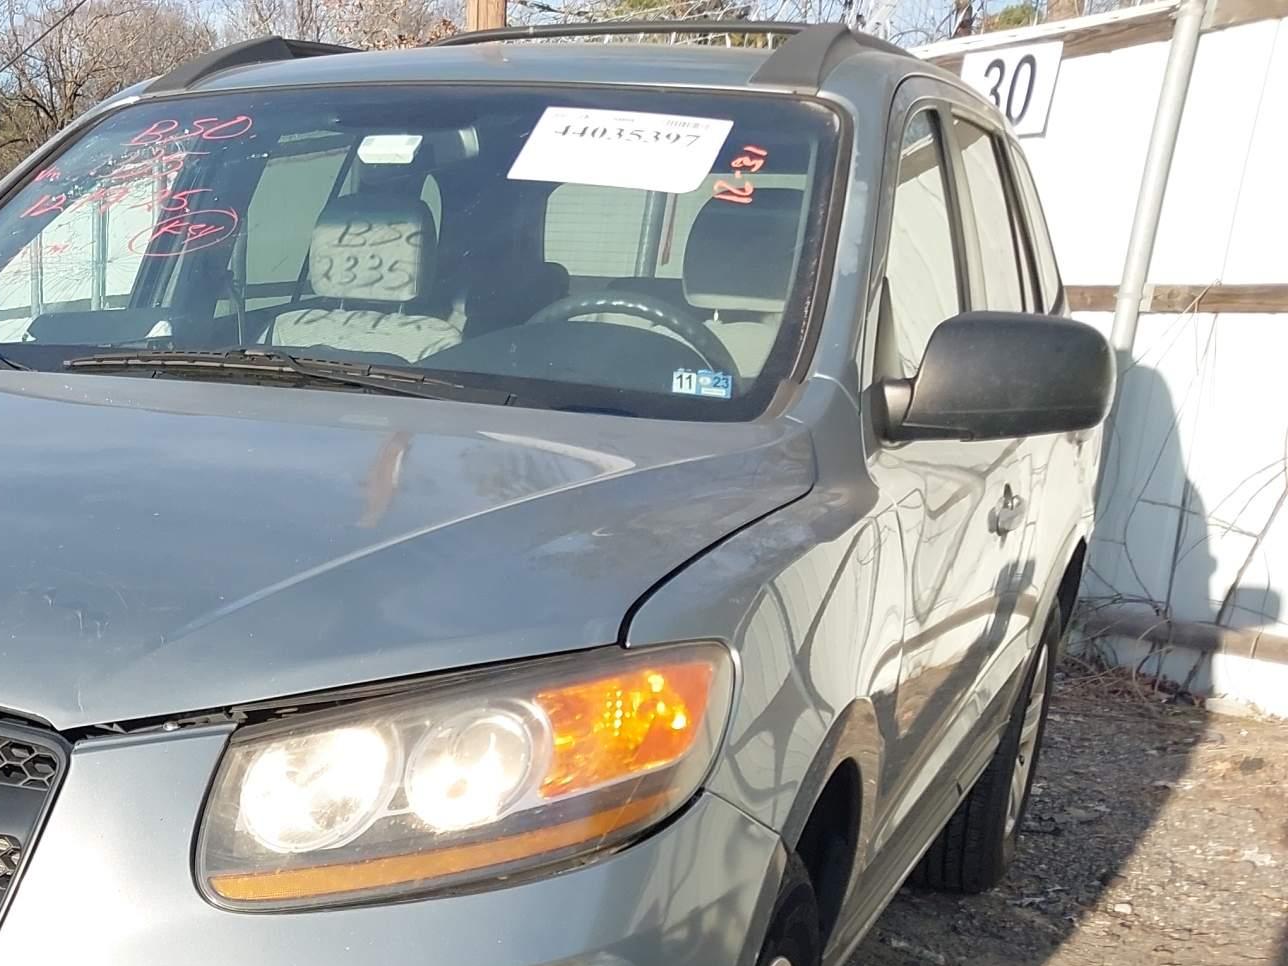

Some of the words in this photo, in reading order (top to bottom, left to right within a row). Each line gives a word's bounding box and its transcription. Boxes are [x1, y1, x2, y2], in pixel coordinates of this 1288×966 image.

[984, 54, 1037, 126] 30
[555, 125, 701, 147] 44035397
[676, 373, 693, 390] 11
[713, 375, 729, 389] 23
